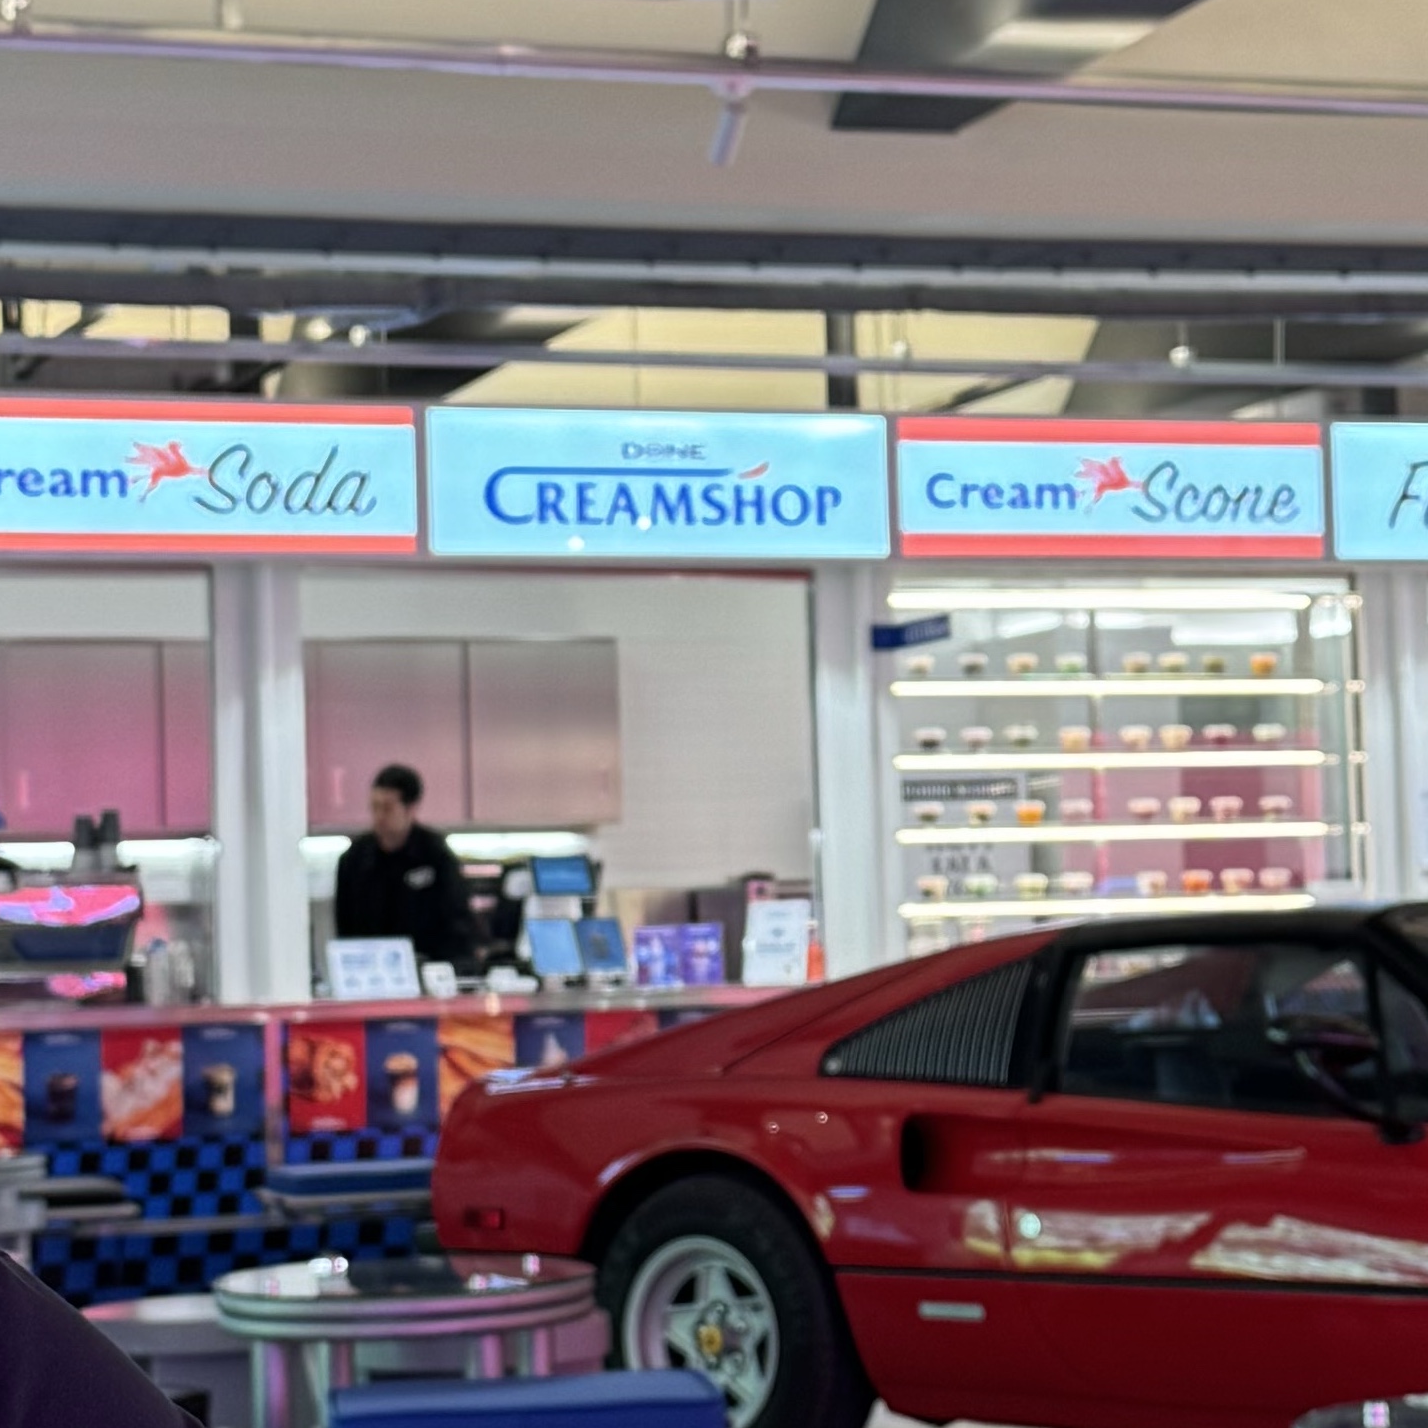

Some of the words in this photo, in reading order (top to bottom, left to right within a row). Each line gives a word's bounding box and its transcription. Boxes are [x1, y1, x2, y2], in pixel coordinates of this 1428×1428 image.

[195, 443, 378, 516] Soda
[483, 466, 843, 527] CREAMSHOP
[925, 472, 1077, 510] Cream
[1132, 461, 1301, 523] Scone
